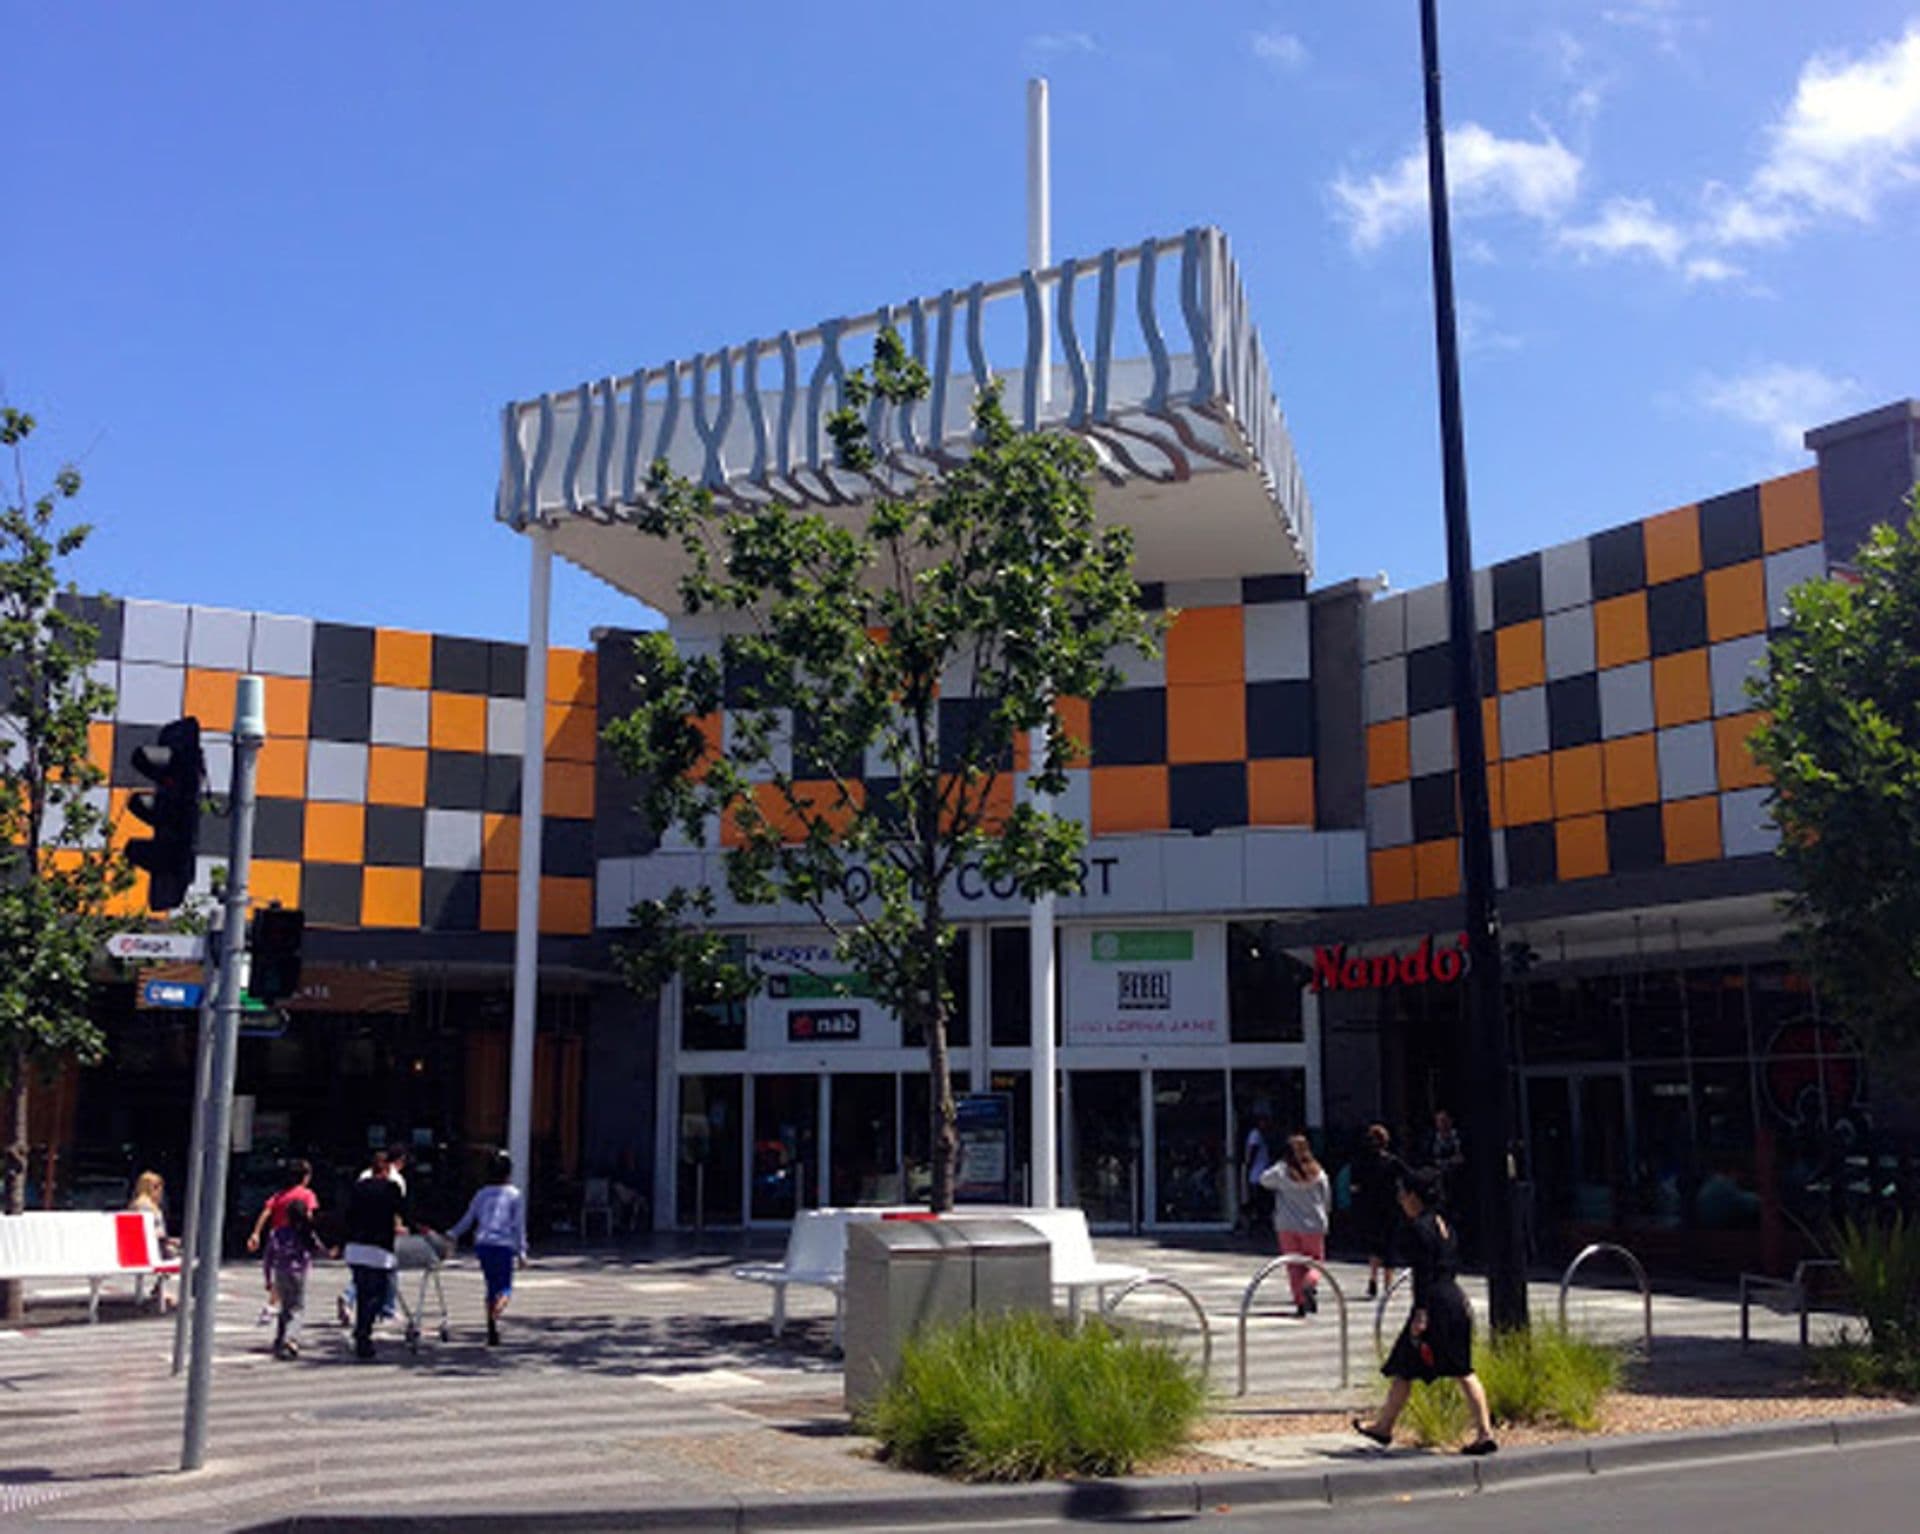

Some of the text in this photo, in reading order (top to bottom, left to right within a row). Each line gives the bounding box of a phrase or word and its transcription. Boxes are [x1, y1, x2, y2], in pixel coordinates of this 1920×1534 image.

[956, 858, 1118, 901] CORT
[1311, 931, 1472, 993] Nando'
[816, 1012, 857, 1034] nab
